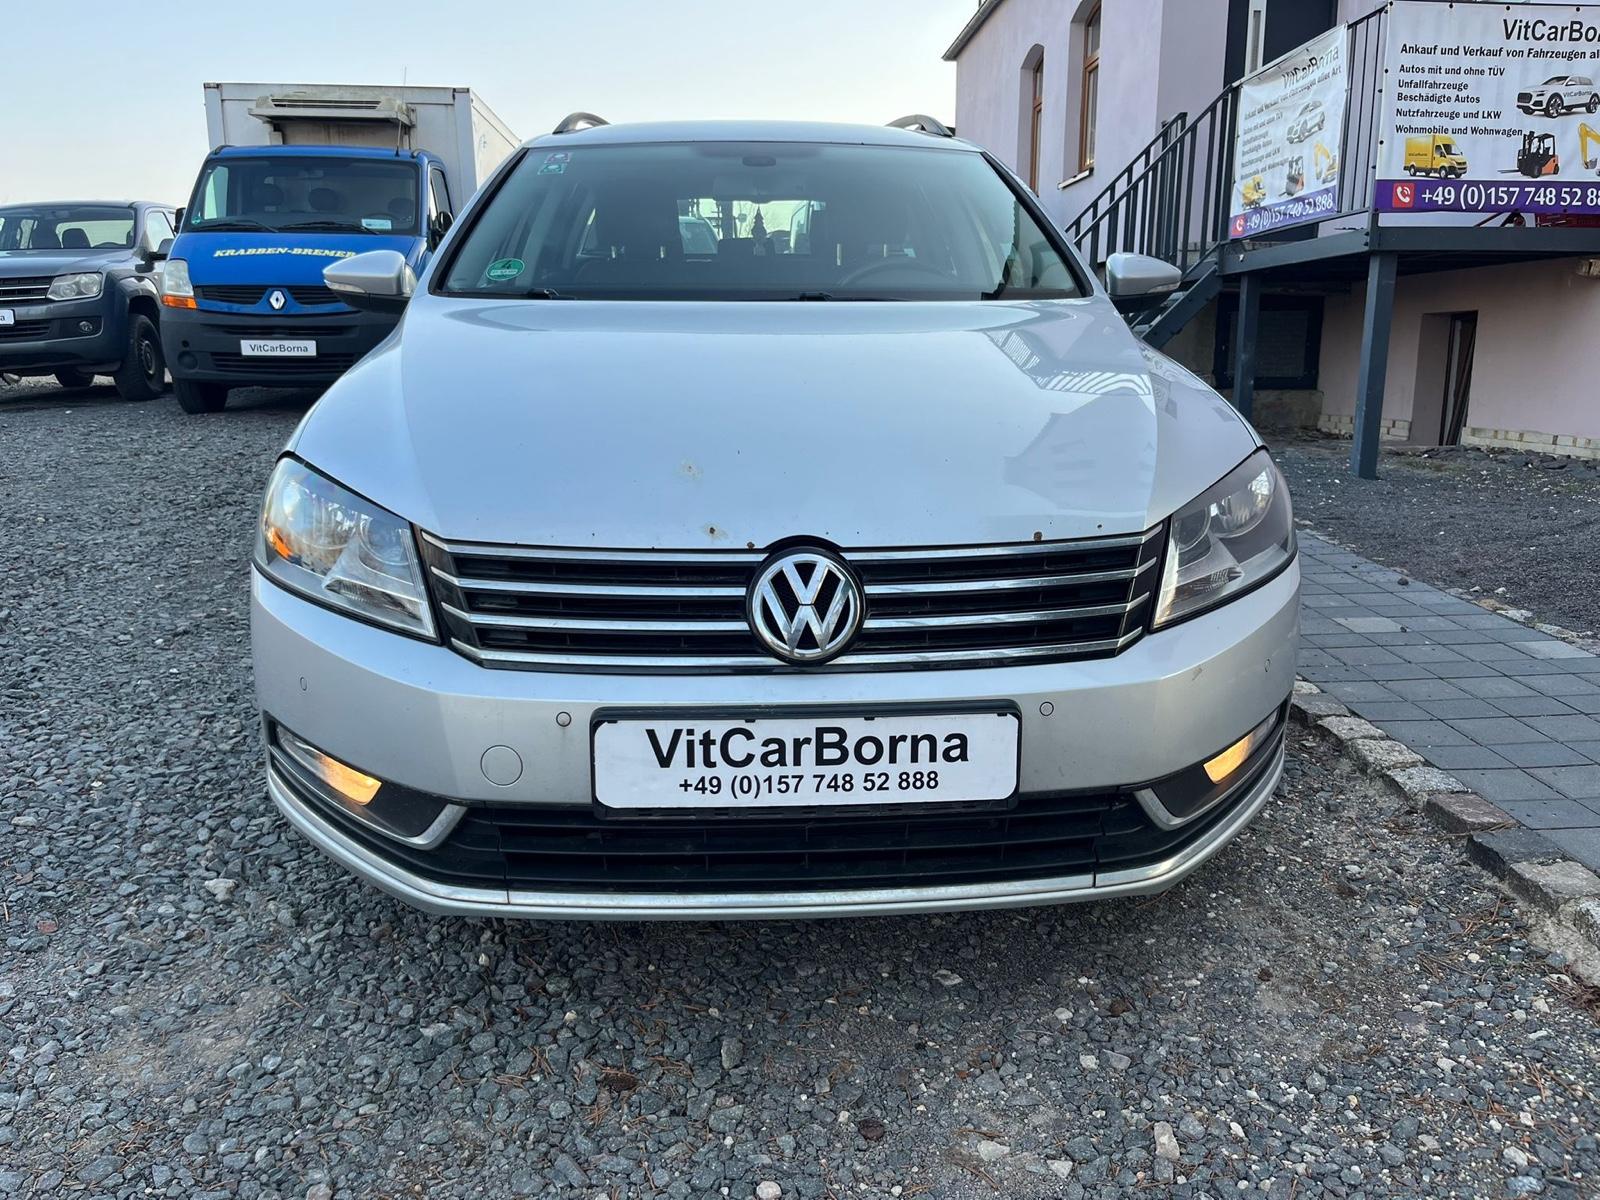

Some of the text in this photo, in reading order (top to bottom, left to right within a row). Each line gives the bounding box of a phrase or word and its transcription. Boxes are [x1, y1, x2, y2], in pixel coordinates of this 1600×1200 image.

[1400, 43, 1438, 55] Ankauf
[1440, 46, 1460, 56] und
[1463, 46, 1503, 58] Verkauf
[1506, 50, 1524, 58] von
[1527, 48, 1586, 61] Fahrzeugen
[1399, 64, 1505, 77] Autos mit und ohne TÜV
[1398, 79, 1469, 92] Unfallfahrzeuge
[1397, 92, 1481, 104] Beschädigte Autos
[1396, 108, 1502, 120] Nutzfahrzeuge und LKW
[1395, 124, 1523, 137] Wohnmobile und Wohnwagen
[1421, 183, 1600, 209] +49 (0)157 748 52 8
[1286, 202, 1303, 219] 748
[1303, 198, 1314, 215] 52
[1315, 193, 1333, 211] 888
[249, 344, 309, 352] VitCarBorna
[645, 726, 969, 768] VitCarBorna
[678, 771, 939, 799] +49 (0)157 748 52 888
